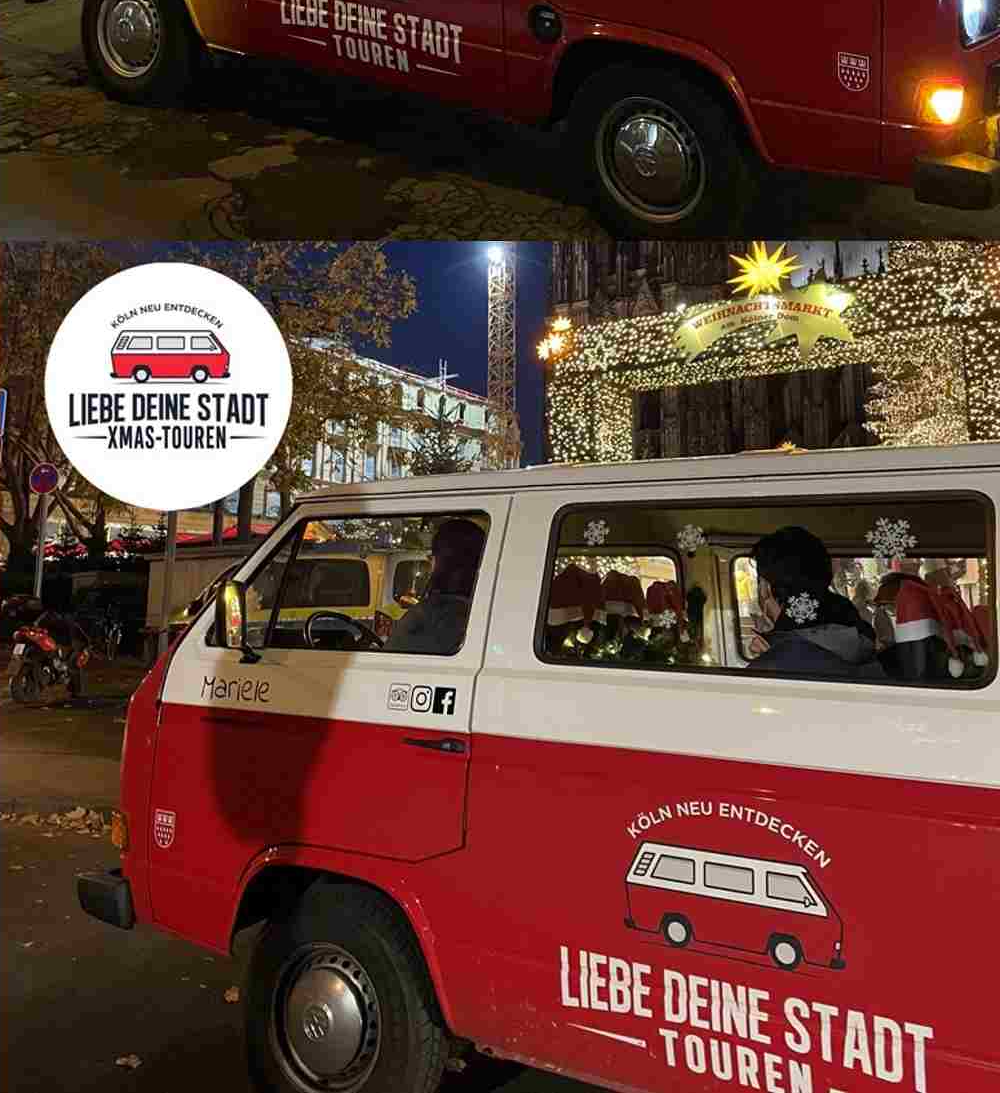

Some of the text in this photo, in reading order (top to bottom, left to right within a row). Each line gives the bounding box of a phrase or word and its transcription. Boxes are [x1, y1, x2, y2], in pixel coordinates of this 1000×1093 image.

[331, 34, 410, 73] TOUREN
[334, 0, 388, 40] DEINE
[393, 12, 463, 64] STADT
[627, 801, 832, 869] KÖLN NEU ENTDECKEN
[559, 946, 934, 1093] LIEBE DEINE STADT
[658, 1028, 814, 1093] TOUREN
